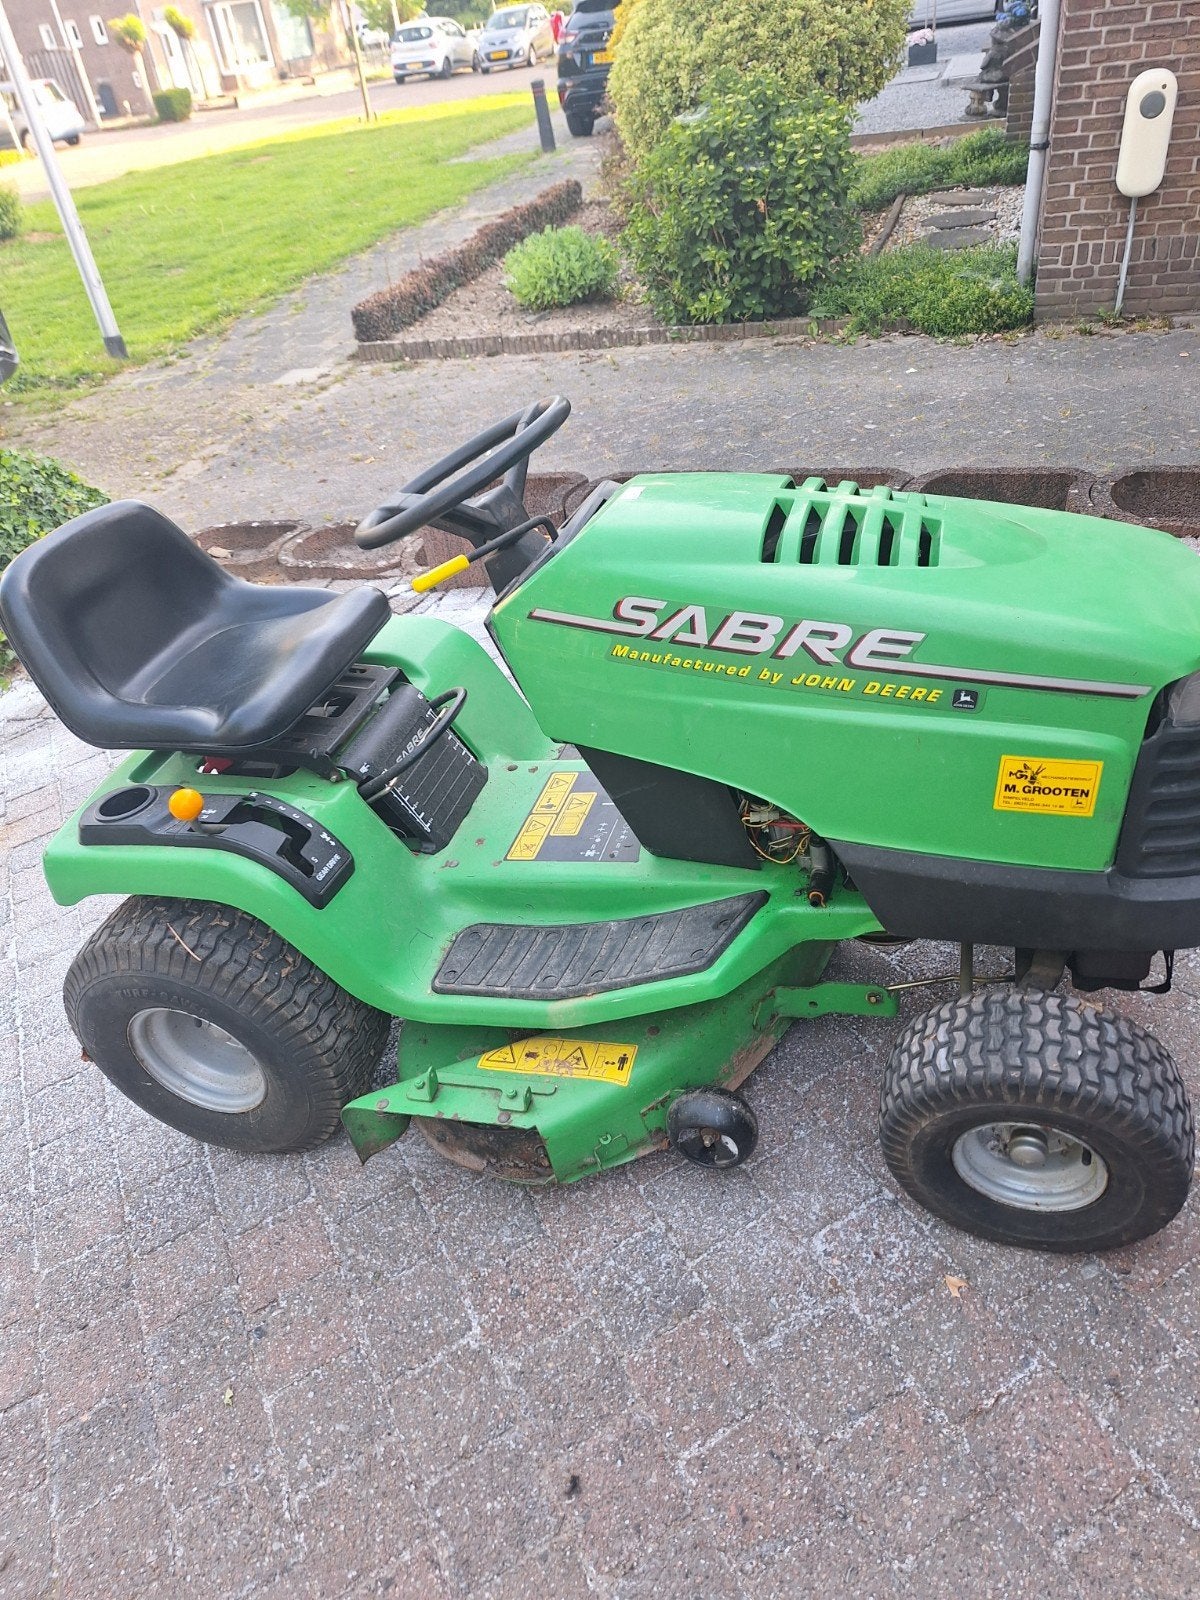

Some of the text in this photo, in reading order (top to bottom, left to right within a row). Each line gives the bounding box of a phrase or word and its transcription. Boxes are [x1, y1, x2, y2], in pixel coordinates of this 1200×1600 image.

[613, 596, 927, 669] SABRE
[611, 644, 943, 703] Manufactured by JOHN DEERE
[1004, 784, 1090, 798] M. GROOTEN
[315, 853, 342, 882] GEAR DRIVE
